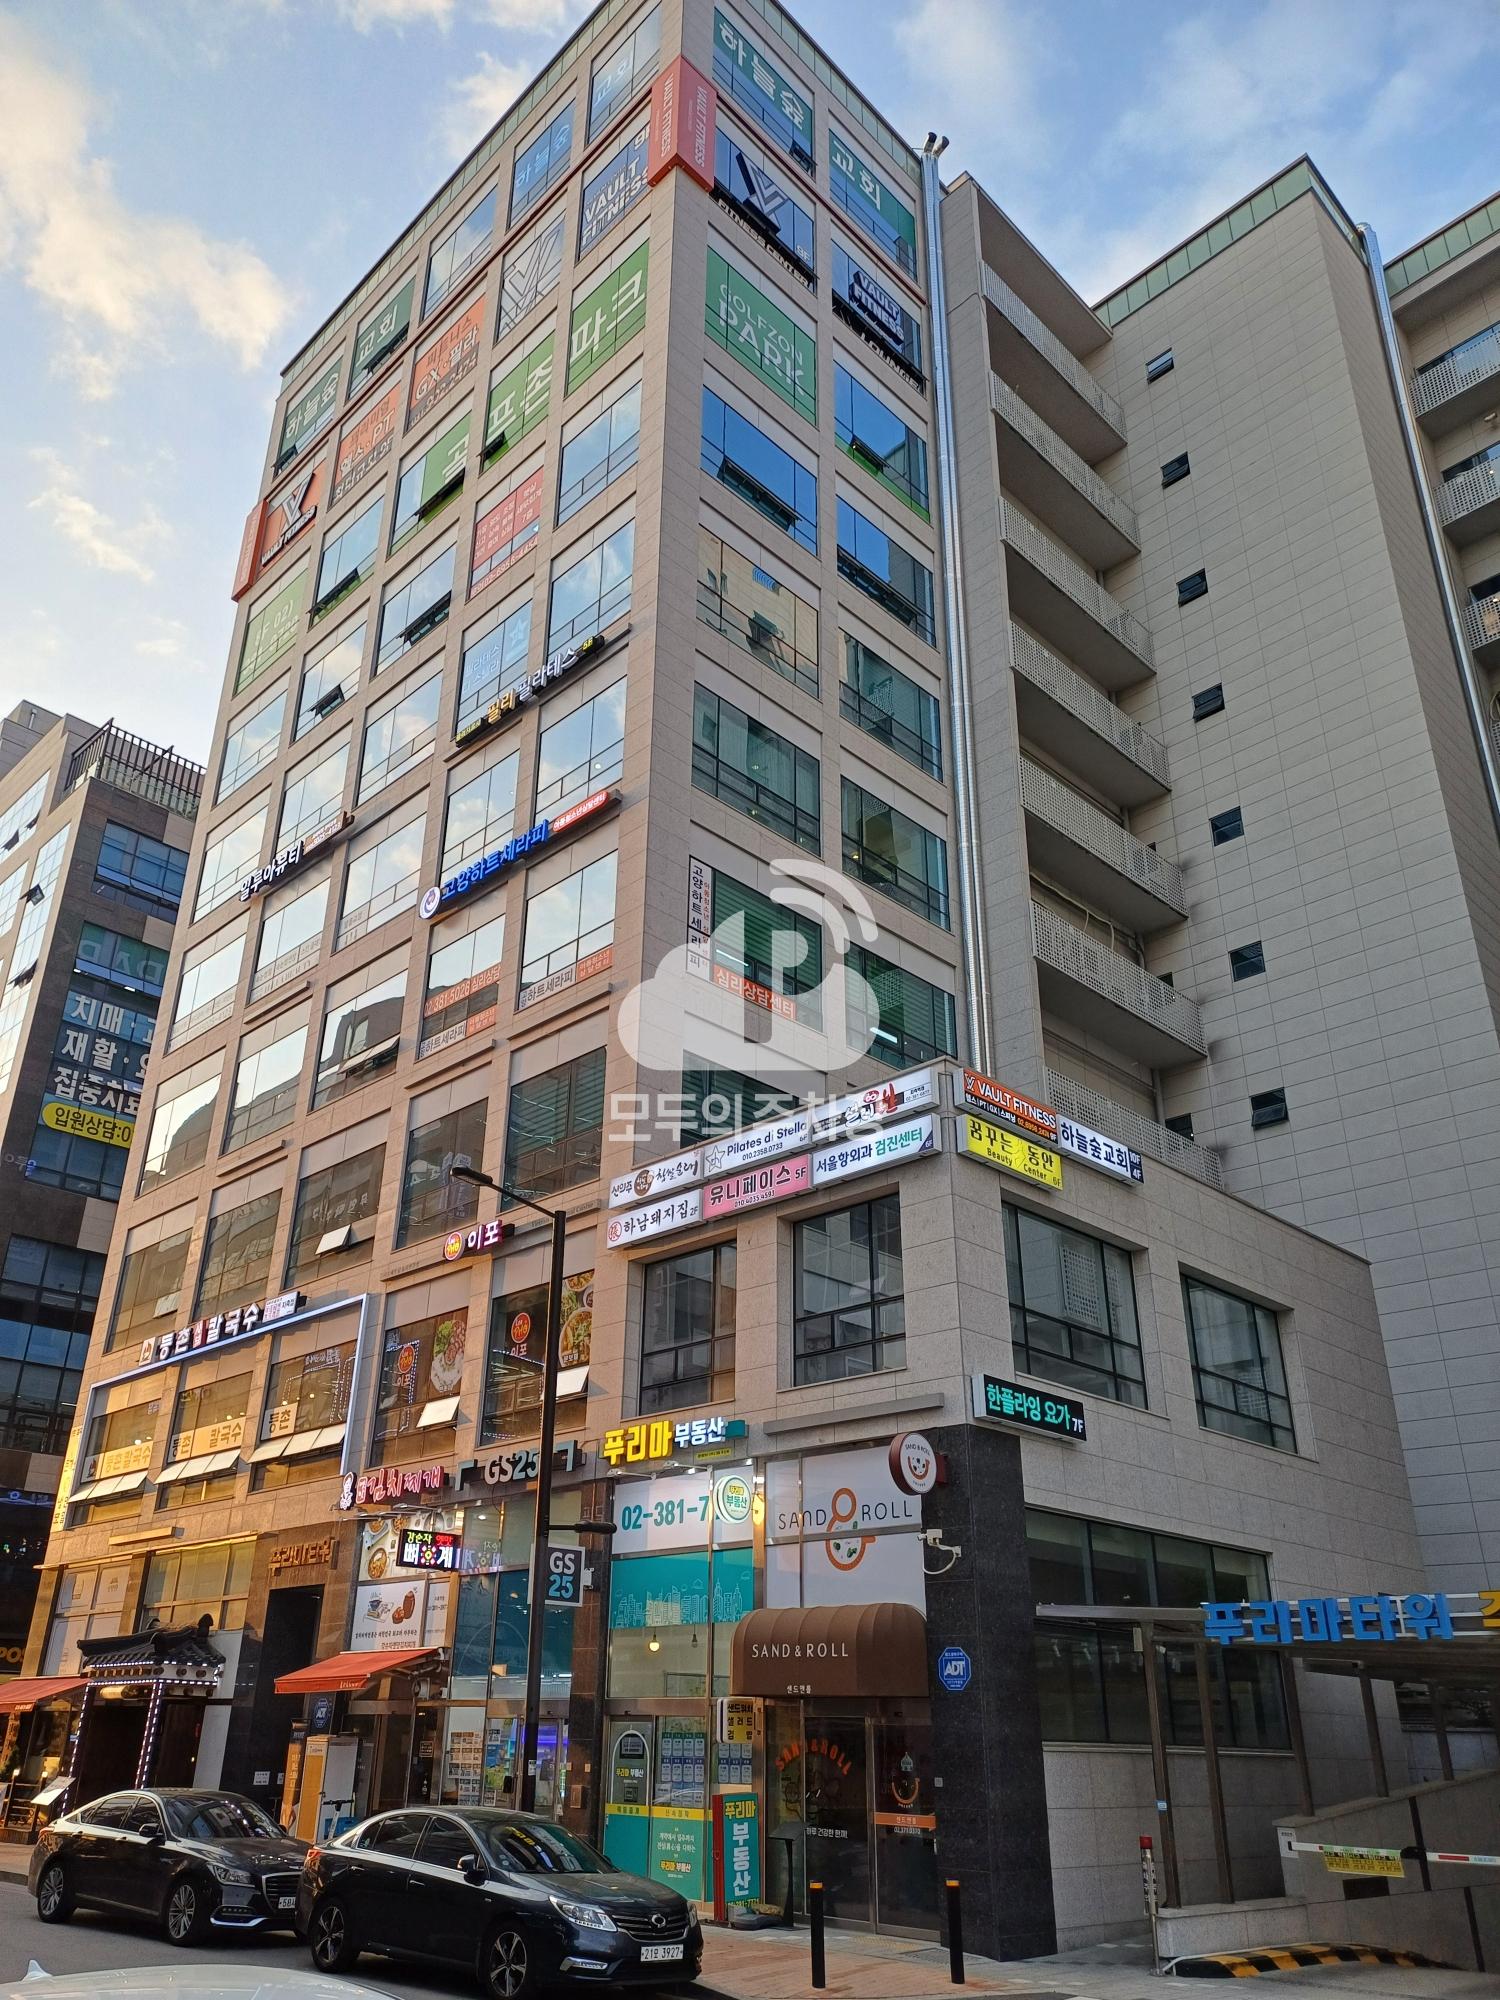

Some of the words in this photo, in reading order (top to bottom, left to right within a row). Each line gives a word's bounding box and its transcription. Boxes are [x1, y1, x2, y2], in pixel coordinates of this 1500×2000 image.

[719, 23, 804, 130] 하늘숲
[833, 139, 881, 211] 교회
[585, 156, 641, 223] VAULT
[718, 199, 766, 248] FITNESS
[766, 244, 810, 288] CENTER
[796, 245, 811, 261] 9F
[853, 286, 905, 341] FITNESS
[857, 271, 900, 318] VAULT
[570, 269, 646, 364] 파크
[720, 283, 803, 366] GOLFZON
[718, 297, 804, 396] PARK
[861, 331, 920, 390] LOUNGE
[286, 372, 339, 439] 하늘숲
[355, 304, 397, 368] 교회
[517, 647, 580, 704] 필라테스
[441, 818, 550, 901] 고양하트세라피
[690, 866, 704, 969] 고양하트세라피
[527, 967, 574, 1002] 하트세라피
[715, 969, 796, 1020] 심리상담센터
[426, 1023, 466, 1052] 하트세라피
[977, 1079, 1012, 1106] VAULT
[1013, 1097, 1057, 1130] FITNESS
[727, 1138, 762, 1157] Pilates
[777, 1121, 807, 1140] Stella
[816, 1143, 873, 1173] 서울항외과
[875, 1127, 923, 1156] 검진센터
[969, 1119, 1014, 1155] 꿈꾸는
[1028, 1144, 1055, 1173] 동안
[1060, 1122, 1129, 1173] 하늘숲교회
[987, 1147, 1013, 1167] Beauty
[1024, 1164, 1048, 1181] Center
[611, 1180, 633, 1198] 신의주
[710, 1165, 791, 1206] 유니페이스
[795, 1166, 807, 1180] 5F
[467, 1220, 501, 1250] 이포
[623, 1200, 689, 1235] 하남돼지집
[690, 1206, 699, 1217] 2F
[159, 1328, 191, 1361] 등촌
[207, 1303, 260, 1344] 칼국수
[510, 1343, 528, 1358] 이포
[268, 1409, 291, 1434] 등촌
[986, 1384, 1041, 1421] 한플라잉
[1044, 1401, 1070, 1430] 요가
[1072, 1418, 1084, 1433] 7F
[171, 1435, 191, 1458] 등촌
[209, 1421, 242, 1448] 칼국수
[604, 1420, 672, 1466] 푸리마
[674, 1417, 726, 1448] 부동산
[484, 1450, 541, 1485] GS25
[621, 1495, 721, 1530] 02-381-7
[726, 1494, 748, 1509] 부동산
[779, 1508, 827, 1531] SAND
[862, 1499, 913, 1522] ROLL
[407, 1531, 432, 1544] 강순자
[549, 1551, 575, 1574] GS
[549, 1575, 574, 1598] 25
[1203, 1592, 1455, 1645] 푸리마타워
[944, 1660, 965, 1678] ADT
[630, 1768, 644, 1778] 부동산
[725, 1800, 756, 1820] 푸리마
[818, 1827, 834, 1838] 건강한
[732, 1822, 752, 1897] 부동산
[661, 1946, 680, 1959] 3927
